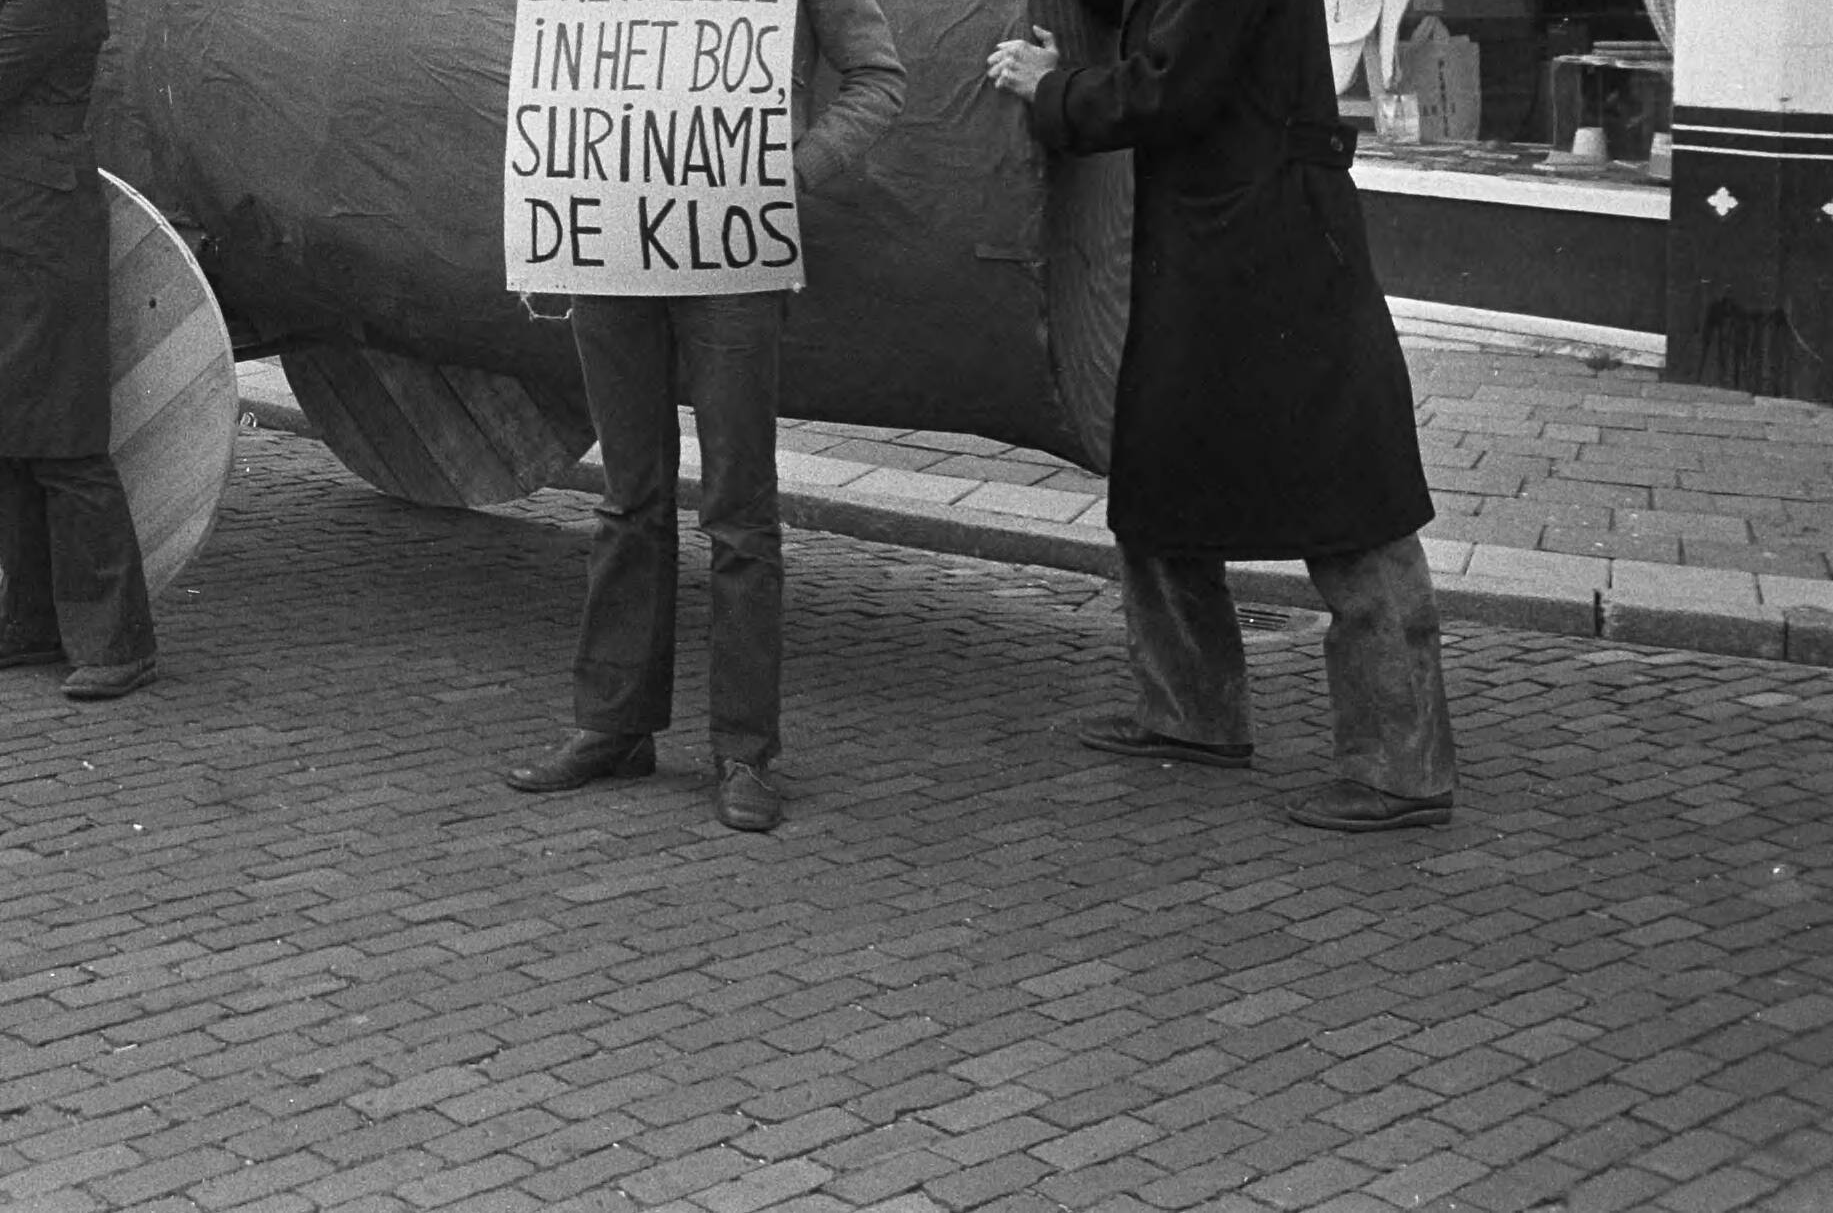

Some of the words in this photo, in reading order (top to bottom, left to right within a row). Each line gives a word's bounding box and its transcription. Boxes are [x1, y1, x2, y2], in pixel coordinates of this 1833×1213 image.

[593, 19, 679, 91] HET
[688, 17, 787, 104] BOS,
[524, 195, 605, 268] DE
[638, 195, 799, 271] KLOS
